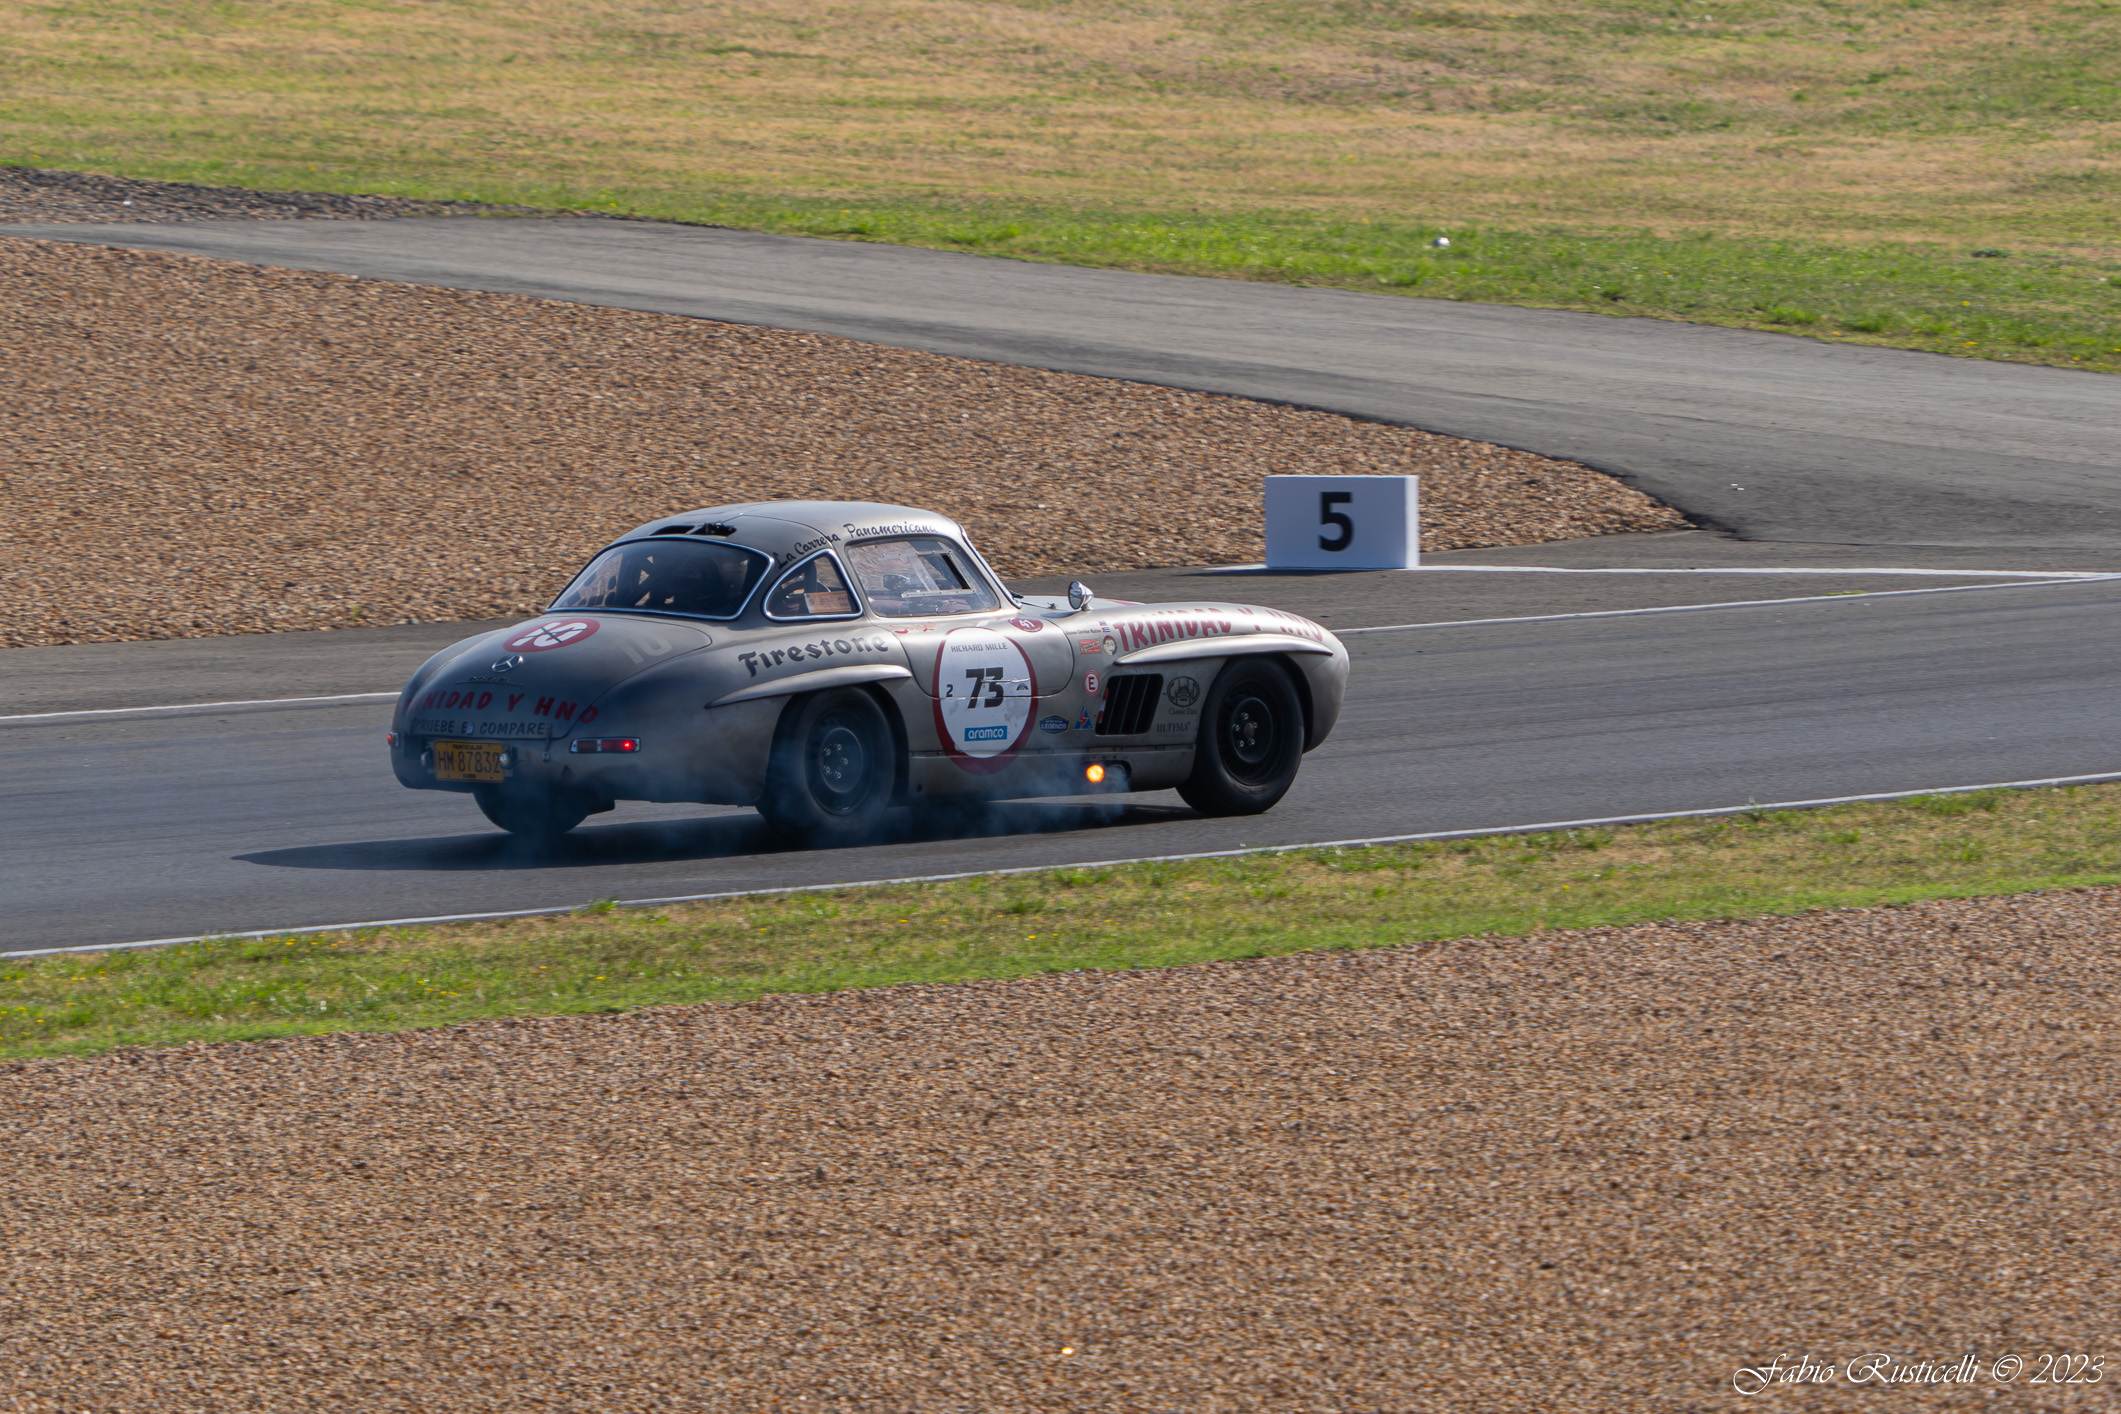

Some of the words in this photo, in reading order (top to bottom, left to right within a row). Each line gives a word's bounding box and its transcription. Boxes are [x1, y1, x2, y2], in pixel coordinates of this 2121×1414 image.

[1318, 491, 1354, 552] 5
[773, 552, 795, 570] La
[794, 532, 841, 553] Carrera
[843, 521, 938, 539] Panamericana
[1018, 618, 1036, 629] 41
[738, 636, 889, 677] Firestone
[950, 644, 984, 653] RICHARD
[985, 642, 1008, 651] MILLE
[946, 684, 954, 698] 2
[965, 666, 1005, 709] 73
[1088, 676, 1096, 691] E
[507, 693, 525, 712] Y
[534, 696, 600, 724] HNO
[968, 728, 1004, 738] aramco
